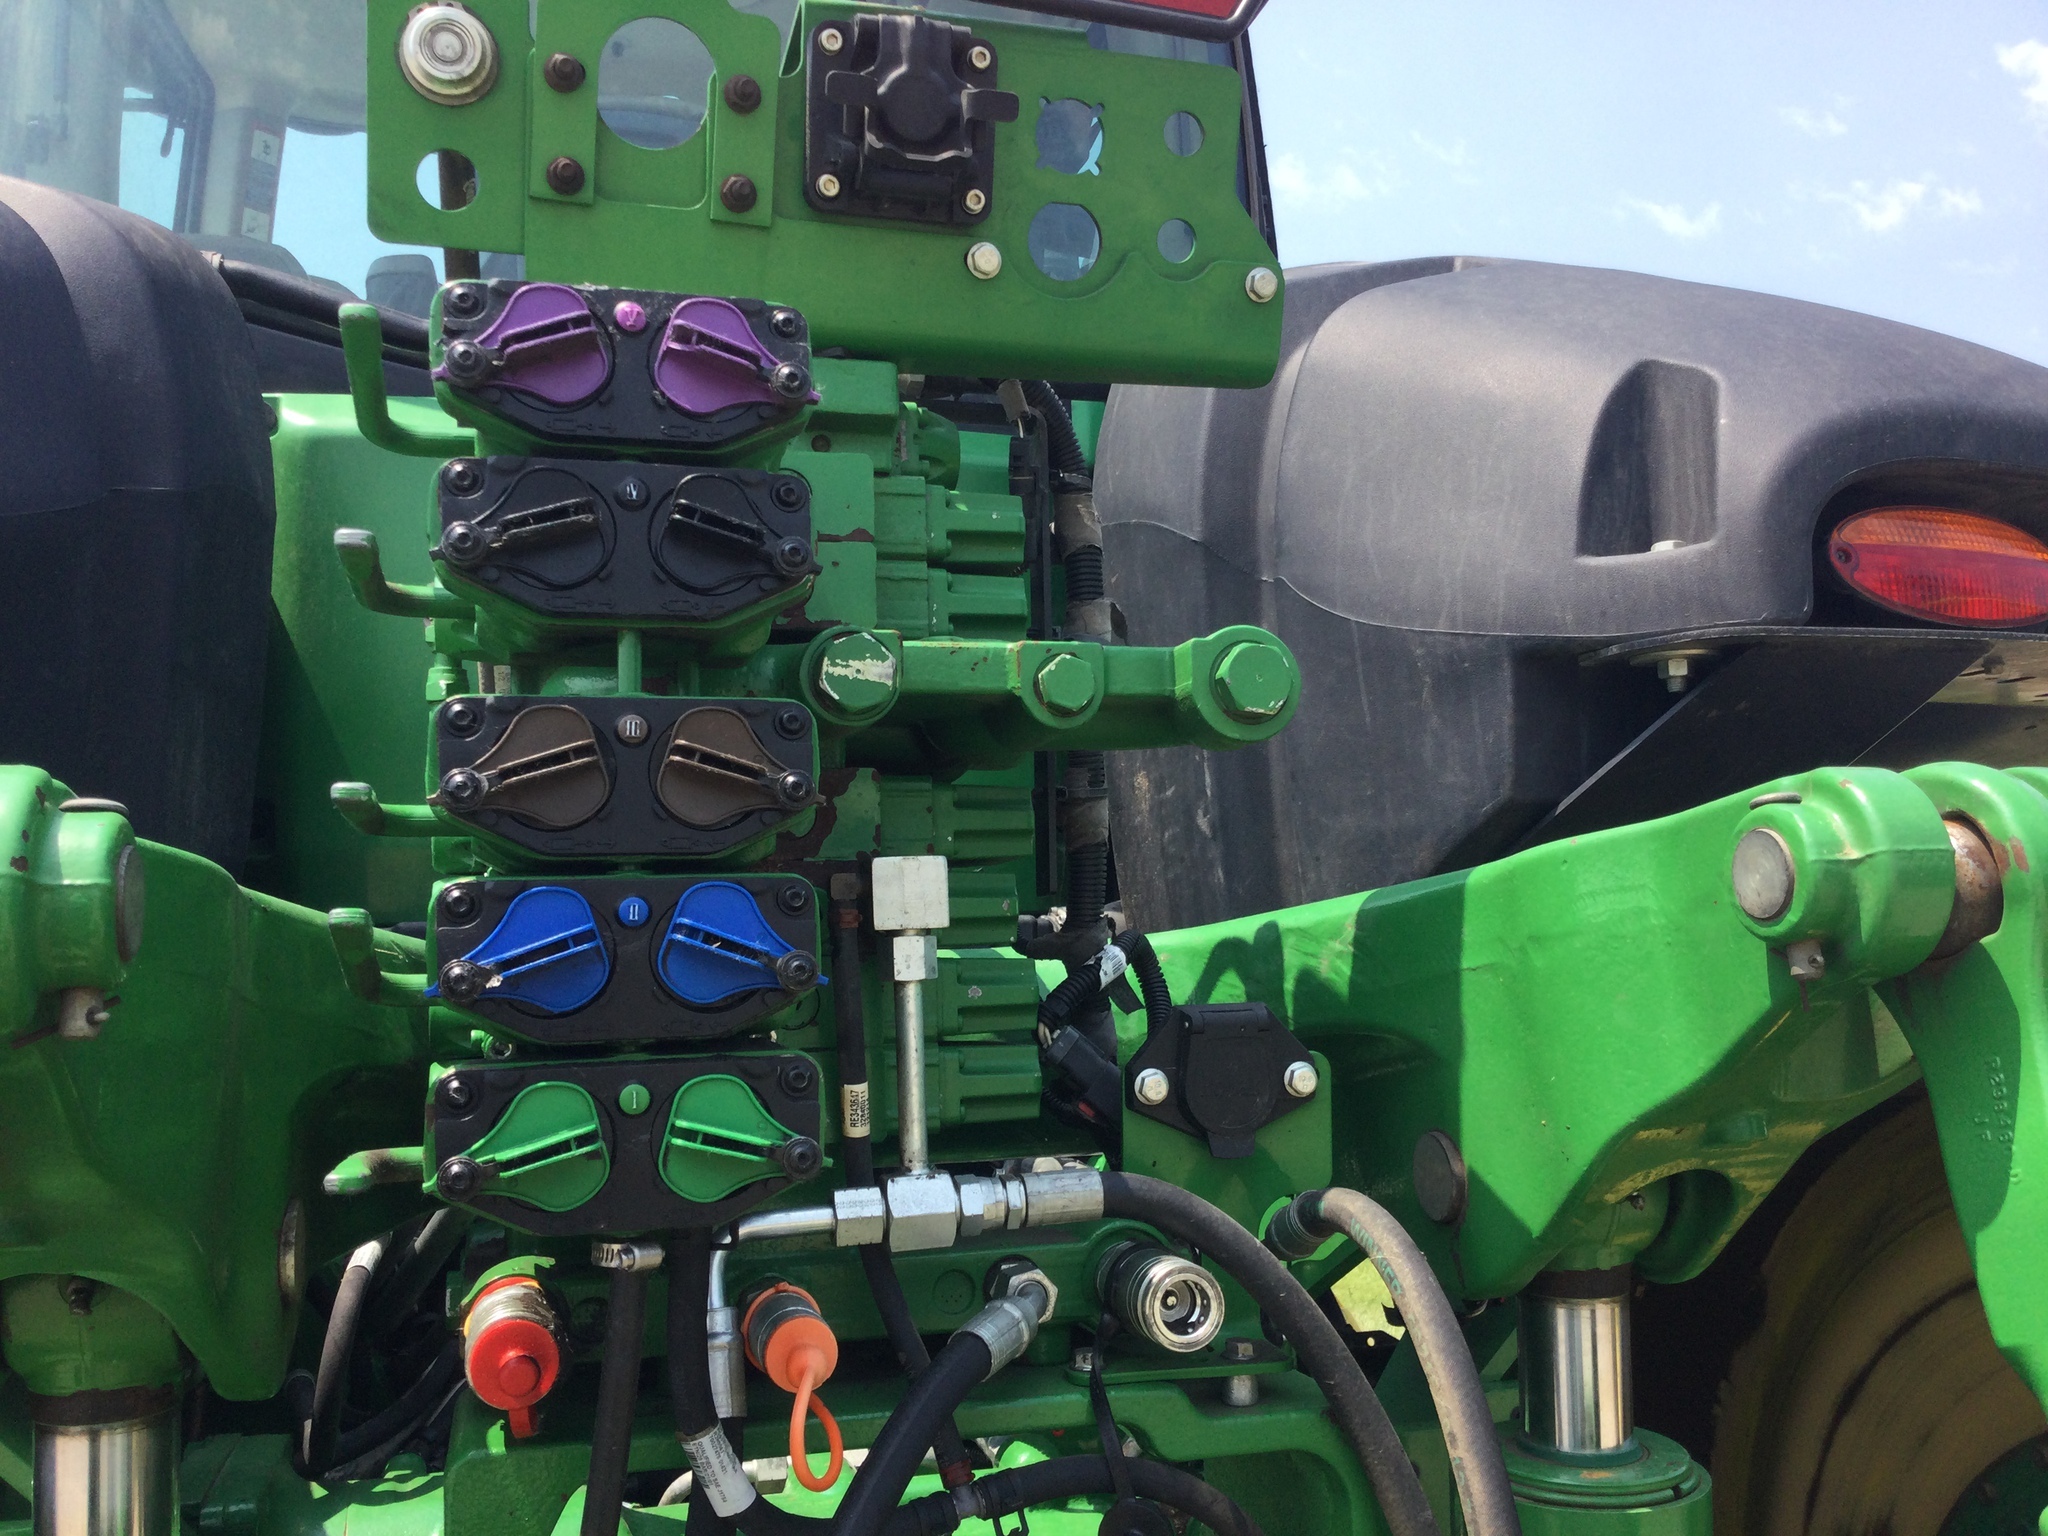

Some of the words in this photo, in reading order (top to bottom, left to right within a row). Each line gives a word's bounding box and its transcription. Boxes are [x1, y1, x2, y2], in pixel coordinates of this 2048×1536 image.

[624, 307, 641, 326] V
[625, 720, 641, 737] III
[629, 903, 640, 921] II
[697, 1441, 713, 1472] QUALIFIED
